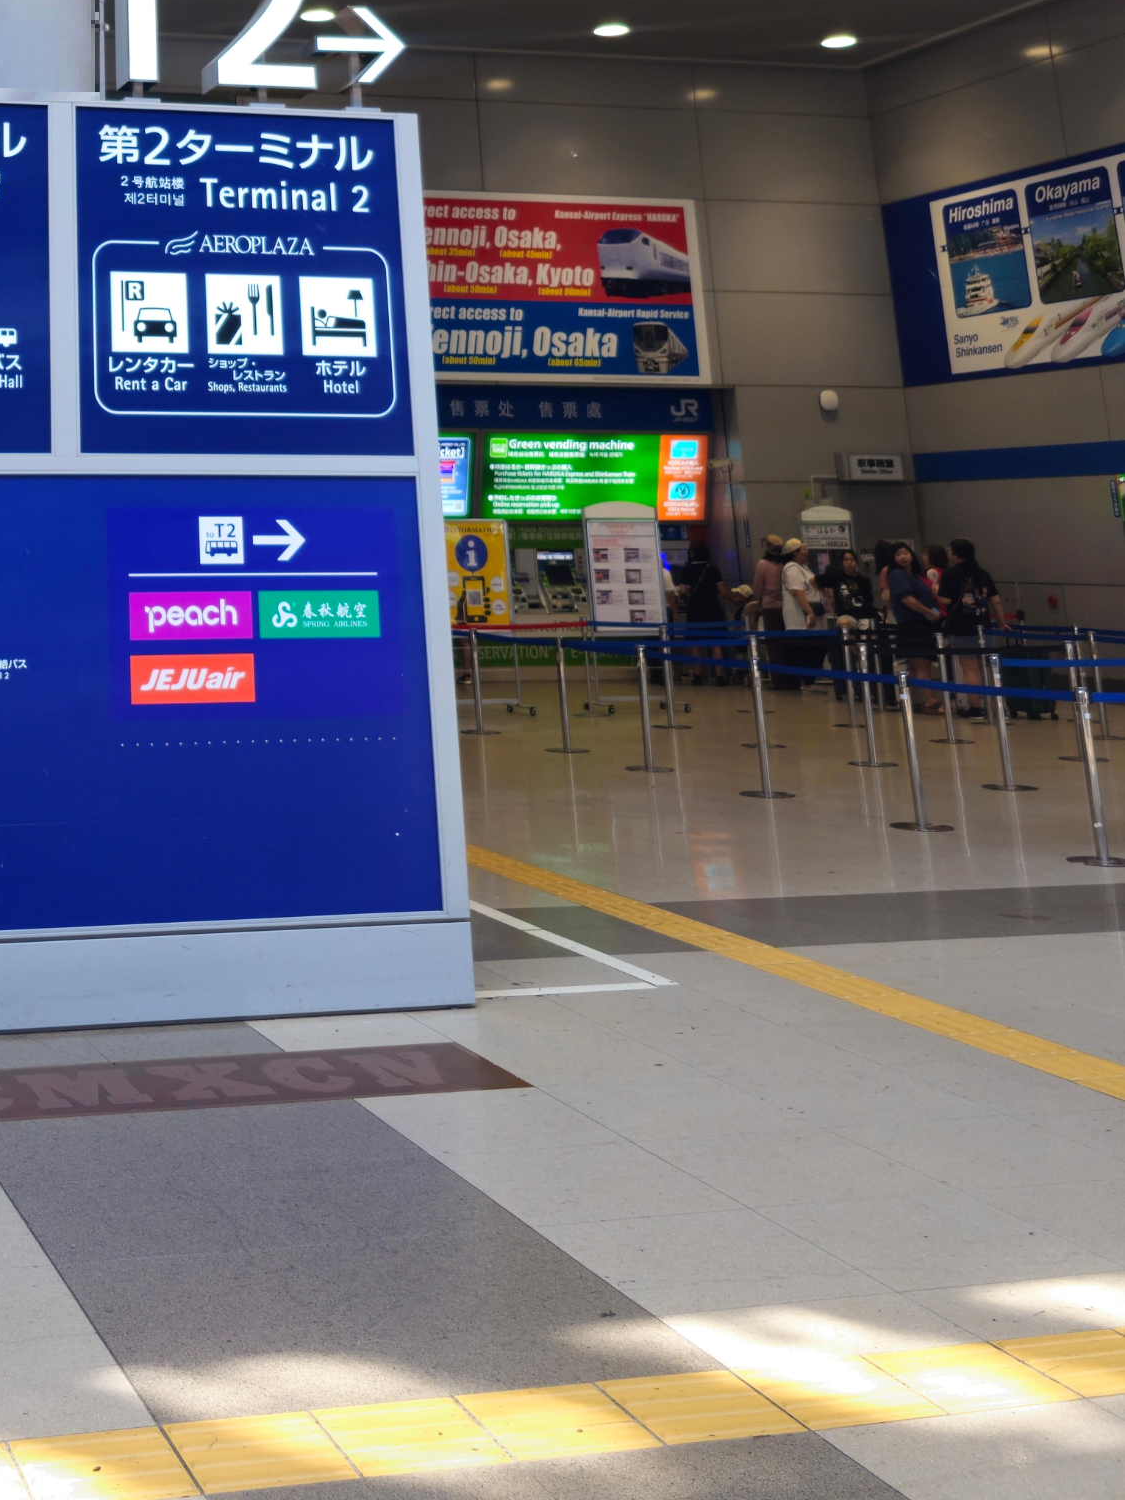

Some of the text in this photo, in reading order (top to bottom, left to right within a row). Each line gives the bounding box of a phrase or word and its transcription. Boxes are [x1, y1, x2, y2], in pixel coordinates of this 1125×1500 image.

[98, 125, 374, 171] 第2ターミナル
[199, 177, 371, 213] Terminal 2
[1034, 175, 1101, 203] Okayama
[123, 191, 185, 207] 제2터미널
[451, 206, 499, 220] access
[502, 207, 516, 220] to
[554, 210, 611, 221] Kansai-Airport
[612, 211, 643, 222] Express
[948, 196, 1014, 224] Hiroshima
[199, 234, 315, 256] AEROPLAZA
[494, 226, 561, 251] Osaka,
[499, 249, 553, 259] (about 45min)
[536, 263, 595, 288] Kyoto
[443, 284, 497, 294] (about 50min)
[538, 286, 563, 295] (about
[458, 307, 506, 320] access
[509, 308, 524, 321] to
[577, 308, 690, 319] Kansai-Airport Rapid Service
[431, 325, 618, 358] ennoji, Osaka
[953, 332, 979, 346] Sanyo
[955, 343, 1003, 358] Shinkansen
[108, 356, 194, 374] レンタカー
[442, 356, 496, 365] (about 50min)
[547, 357, 573, 366] (about
[232, 369, 286, 382] レストラン
[315, 360, 366, 377] ホテル
[114, 376, 188, 392] Rent a Car
[207, 381, 287, 393] Shops, Restaurants
[323, 379, 360, 394] Hotel
[670, 399, 699, 416] JR
[508, 438, 635, 452] Green vending machine
[492, 501, 509, 509] Online
[510, 501, 541, 509] reservation
[144, 598, 238, 634] peach
[301, 601, 367, 619] 春秋航空
[302, 619, 368, 628] SPRING AIRLINES
[4, 672, 9, 680] 2
